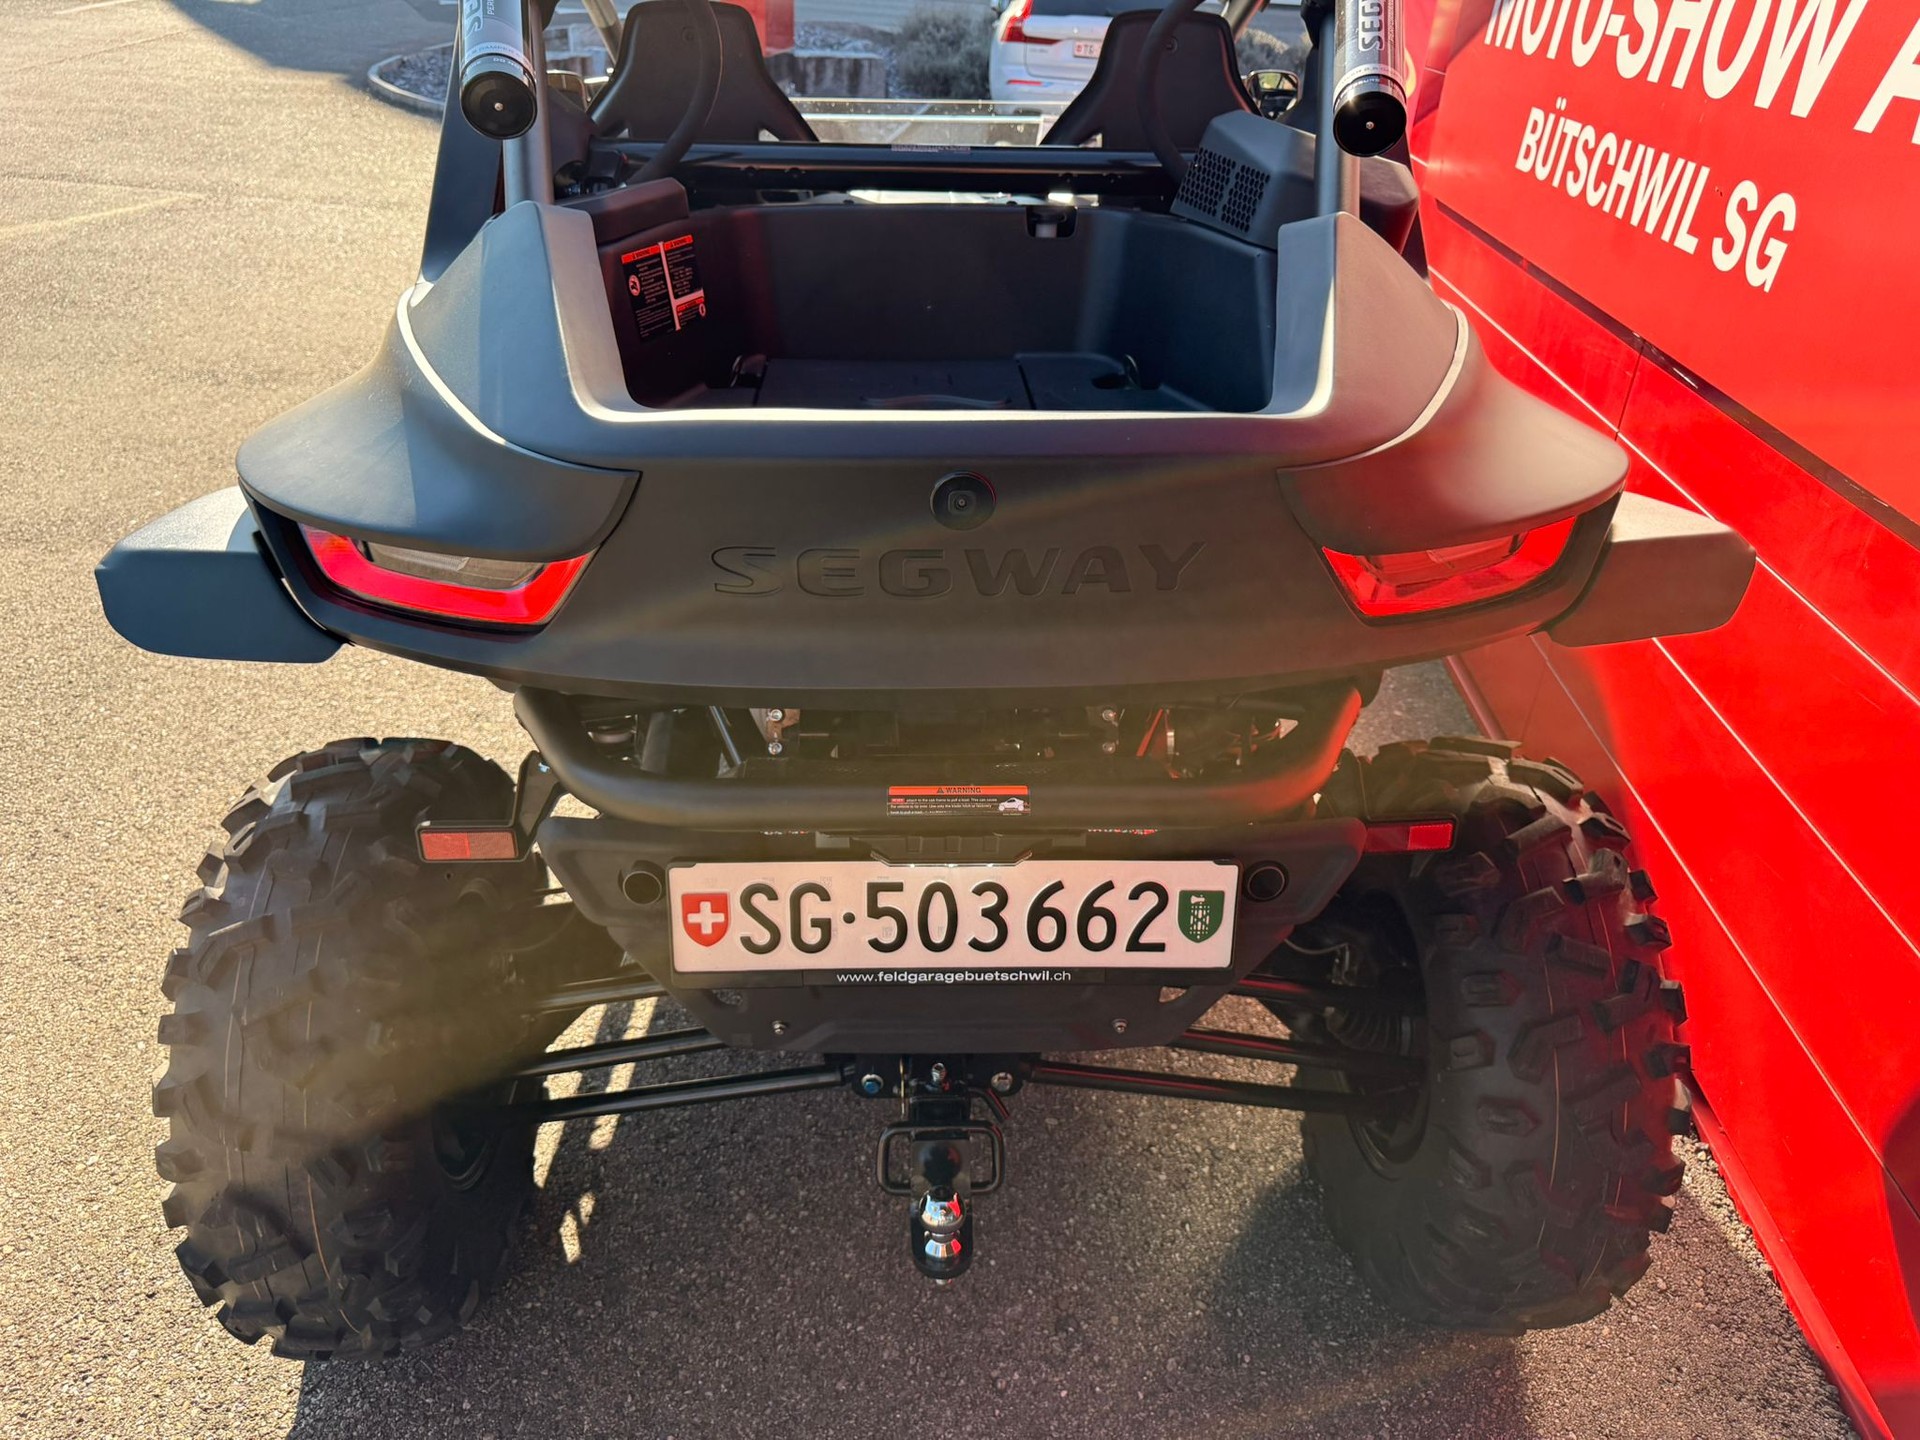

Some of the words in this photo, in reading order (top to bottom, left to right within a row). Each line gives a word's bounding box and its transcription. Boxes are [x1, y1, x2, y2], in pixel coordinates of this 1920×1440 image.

[1360, 0, 1384, 50] SEG
[1515, 97, 1710, 255] BÜTSCHWIL
[1711, 180, 1797, 293] SG
[711, 541, 1206, 597] SEGWAY
[836, 970, 1071, 984] www.feldgaragebuetschwil.ch
